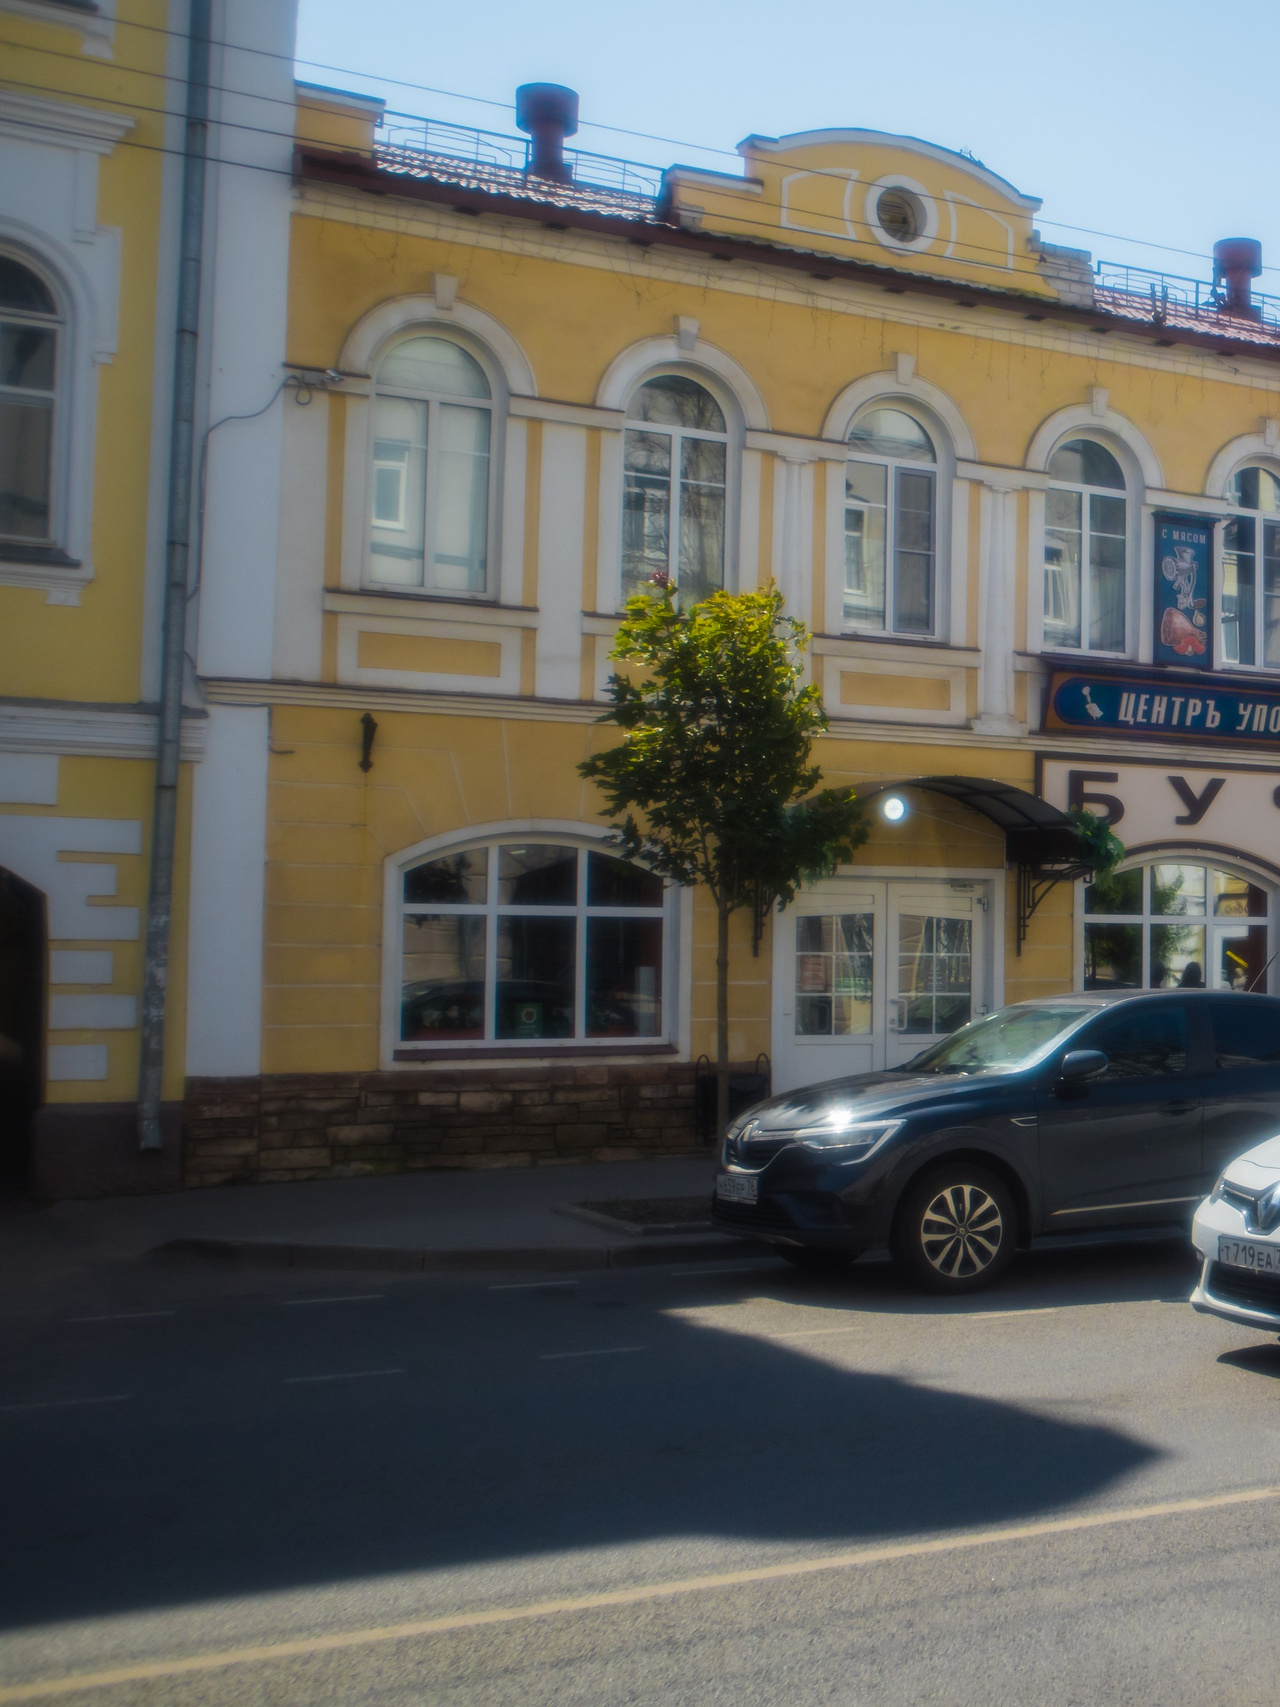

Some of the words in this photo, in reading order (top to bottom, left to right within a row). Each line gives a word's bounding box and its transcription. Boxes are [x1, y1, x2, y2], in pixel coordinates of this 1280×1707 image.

[1161, 529, 1168, 539] С
[1172, 530, 1206, 544] МЯСОМ
[1117, 691, 1222, 729] ЦЕНТРЪ
